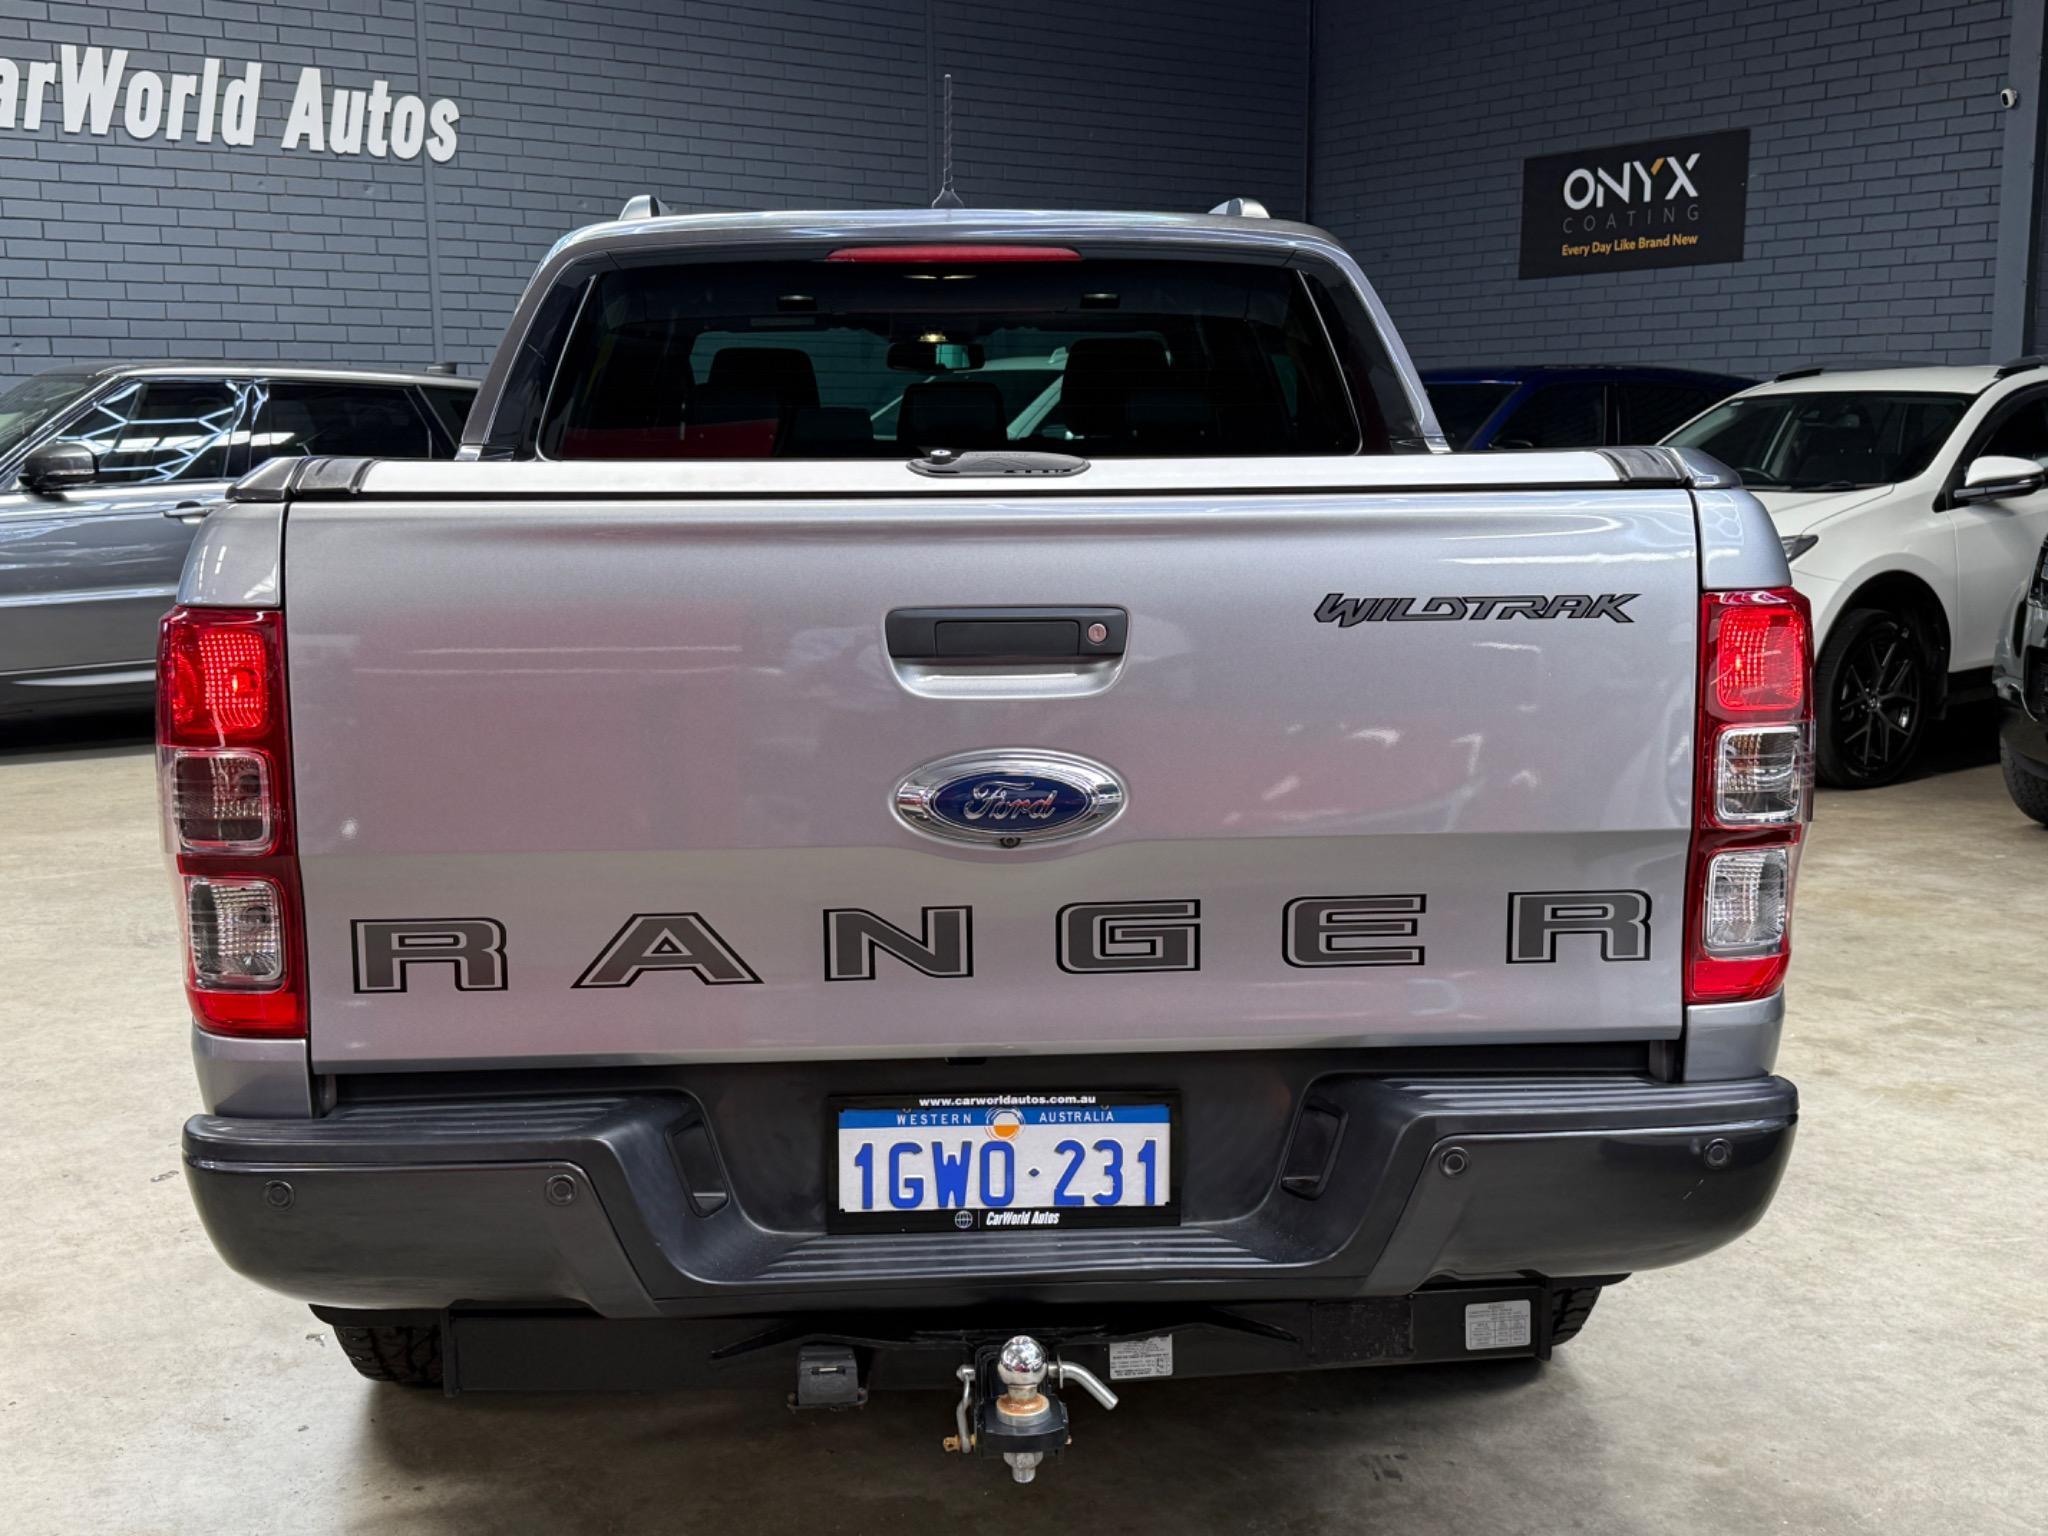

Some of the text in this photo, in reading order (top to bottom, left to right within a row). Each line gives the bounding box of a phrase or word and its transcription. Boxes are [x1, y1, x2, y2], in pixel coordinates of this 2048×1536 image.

[281, 67, 460, 162] Autos
[1563, 153, 1700, 210] ONYX
[1562, 204, 1700, 234] COATING
[1562, 233, 1698, 257] Every Day Like Brand New
[1313, 593, 1642, 628] WILDTRAK
[963, 780, 1057, 820] Ford
[351, 889, 1652, 993] RANGER
[919, 1094, 1096, 1107] www.carworldautos.com.au
[896, 1110, 1114, 1126] WESTERN AUSTRALIA
[985, 1211, 1060, 1227] CarWorld Autos
